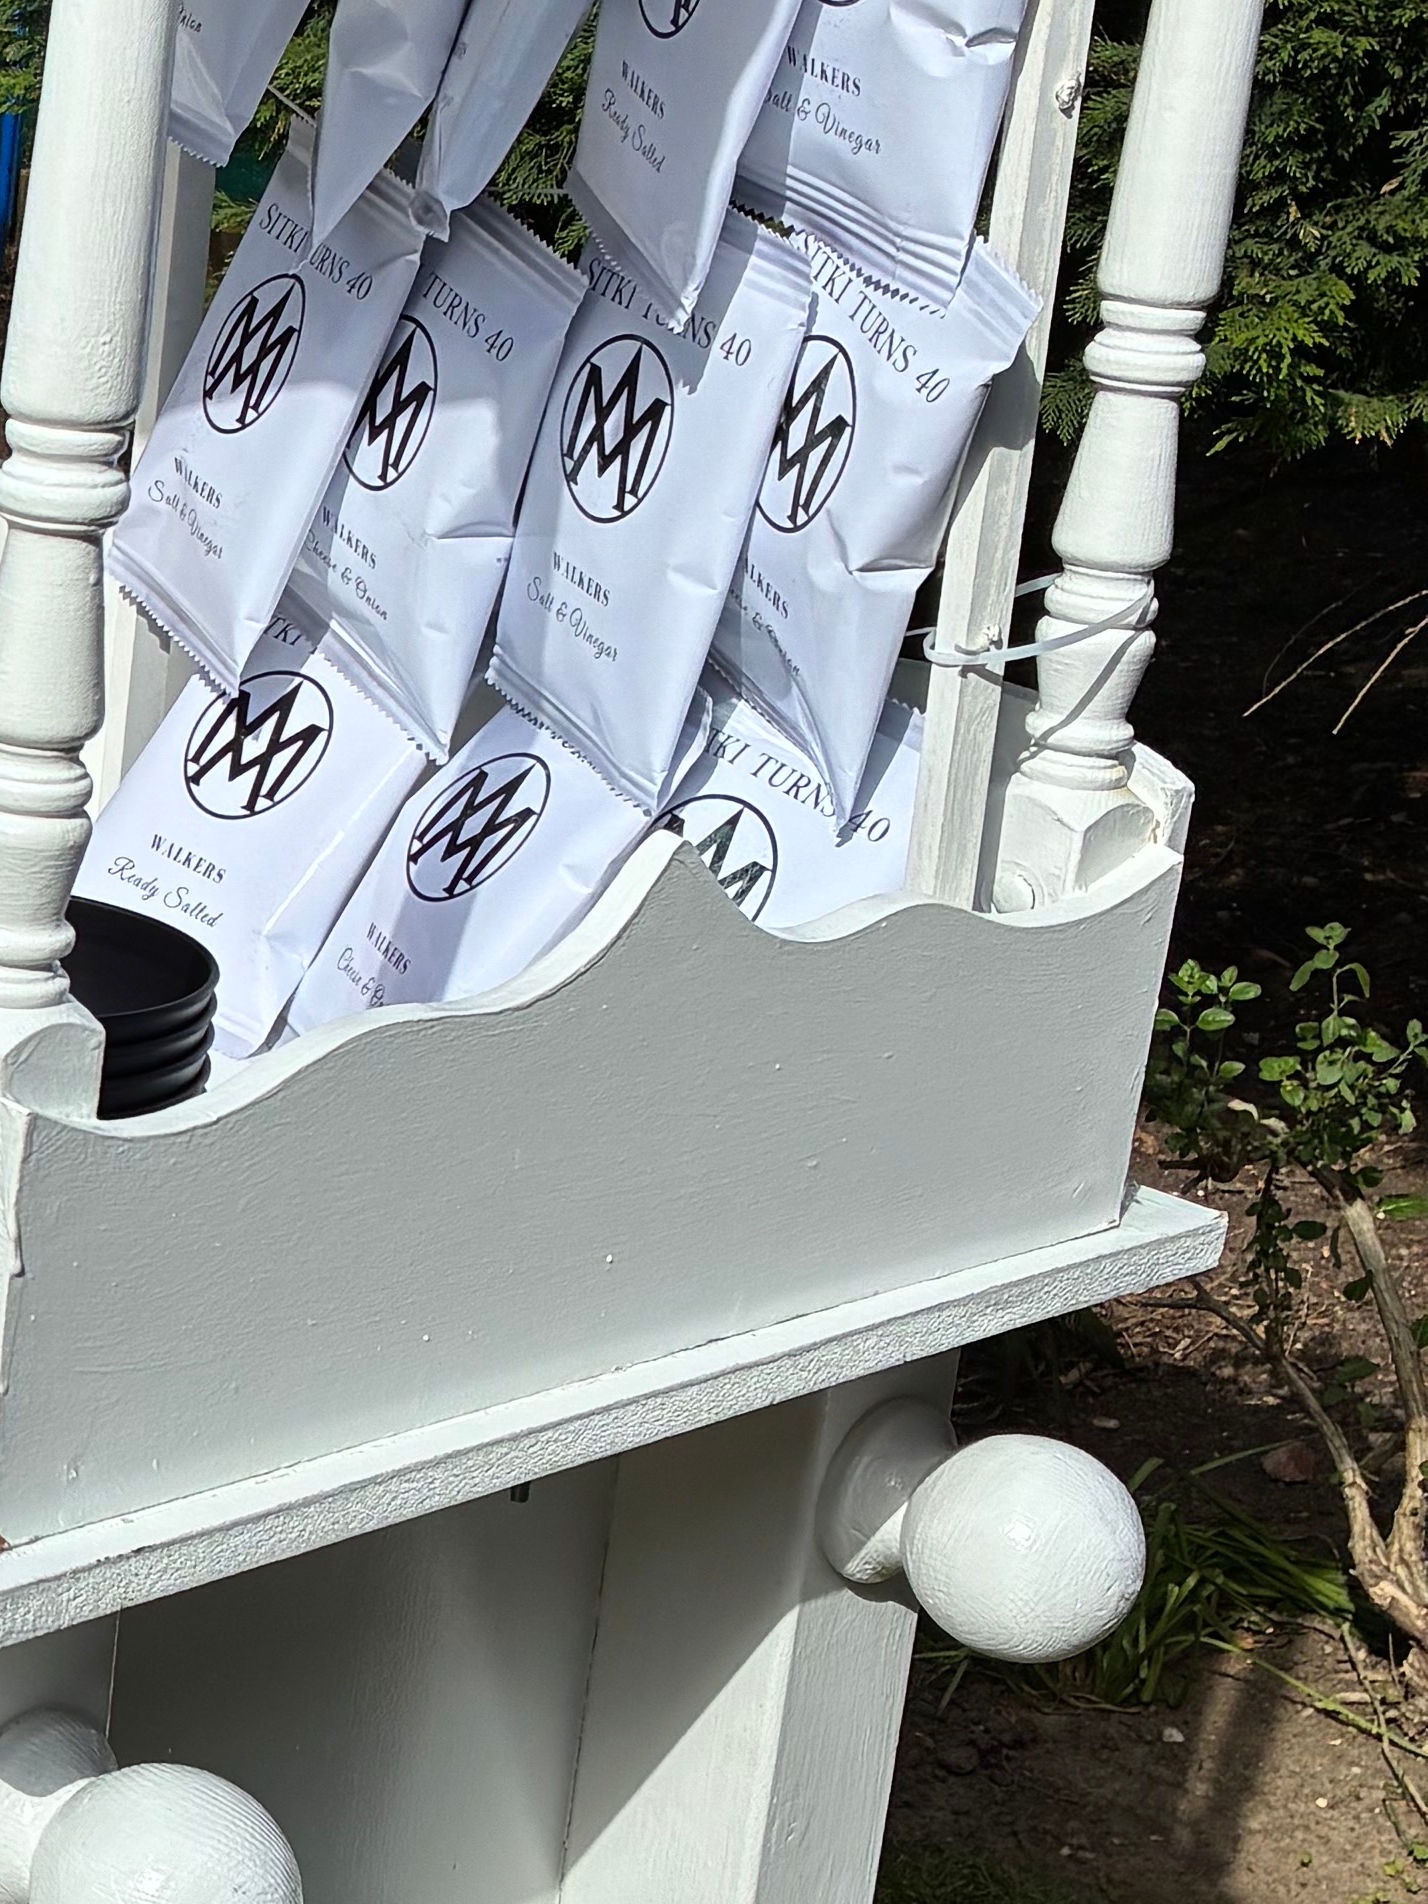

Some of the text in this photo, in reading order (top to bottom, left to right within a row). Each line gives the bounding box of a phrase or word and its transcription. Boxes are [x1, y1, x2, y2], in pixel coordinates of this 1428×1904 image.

[621, 59, 666, 120] WALKERS
[786, 45, 862, 97] WALKERS
[601, 87, 666, 174] Ready Salted
[797, 98, 811, 122] &
[815, 102, 882, 155] Vinegar
[259, 202, 309, 253] SITKI
[345, 271, 374, 301] 40
[422, 271, 514, 362] TURNS 40
[588, 257, 638, 310] SITKI
[719, 332, 753, 367] 40
[848, 290, 918, 373] TURNS
[915, 368, 951, 403] 40
[174, 456, 223, 509] WALKERS
[147, 480, 181, 512] Salt
[187, 508, 223, 559] Vinegar
[322, 506, 377, 570] WALKERS
[341, 567, 353, 586] &
[553, 551, 611, 607] WALKERS
[745, 556, 789, 619] ALKERS
[527, 576, 618, 662] Salt & Vinegar
[849, 808, 891, 842] 40
[151, 833, 227, 884] WALKERS
[108, 856, 224, 928] Ready Salted
[366, 921, 412, 975] WALKERS
